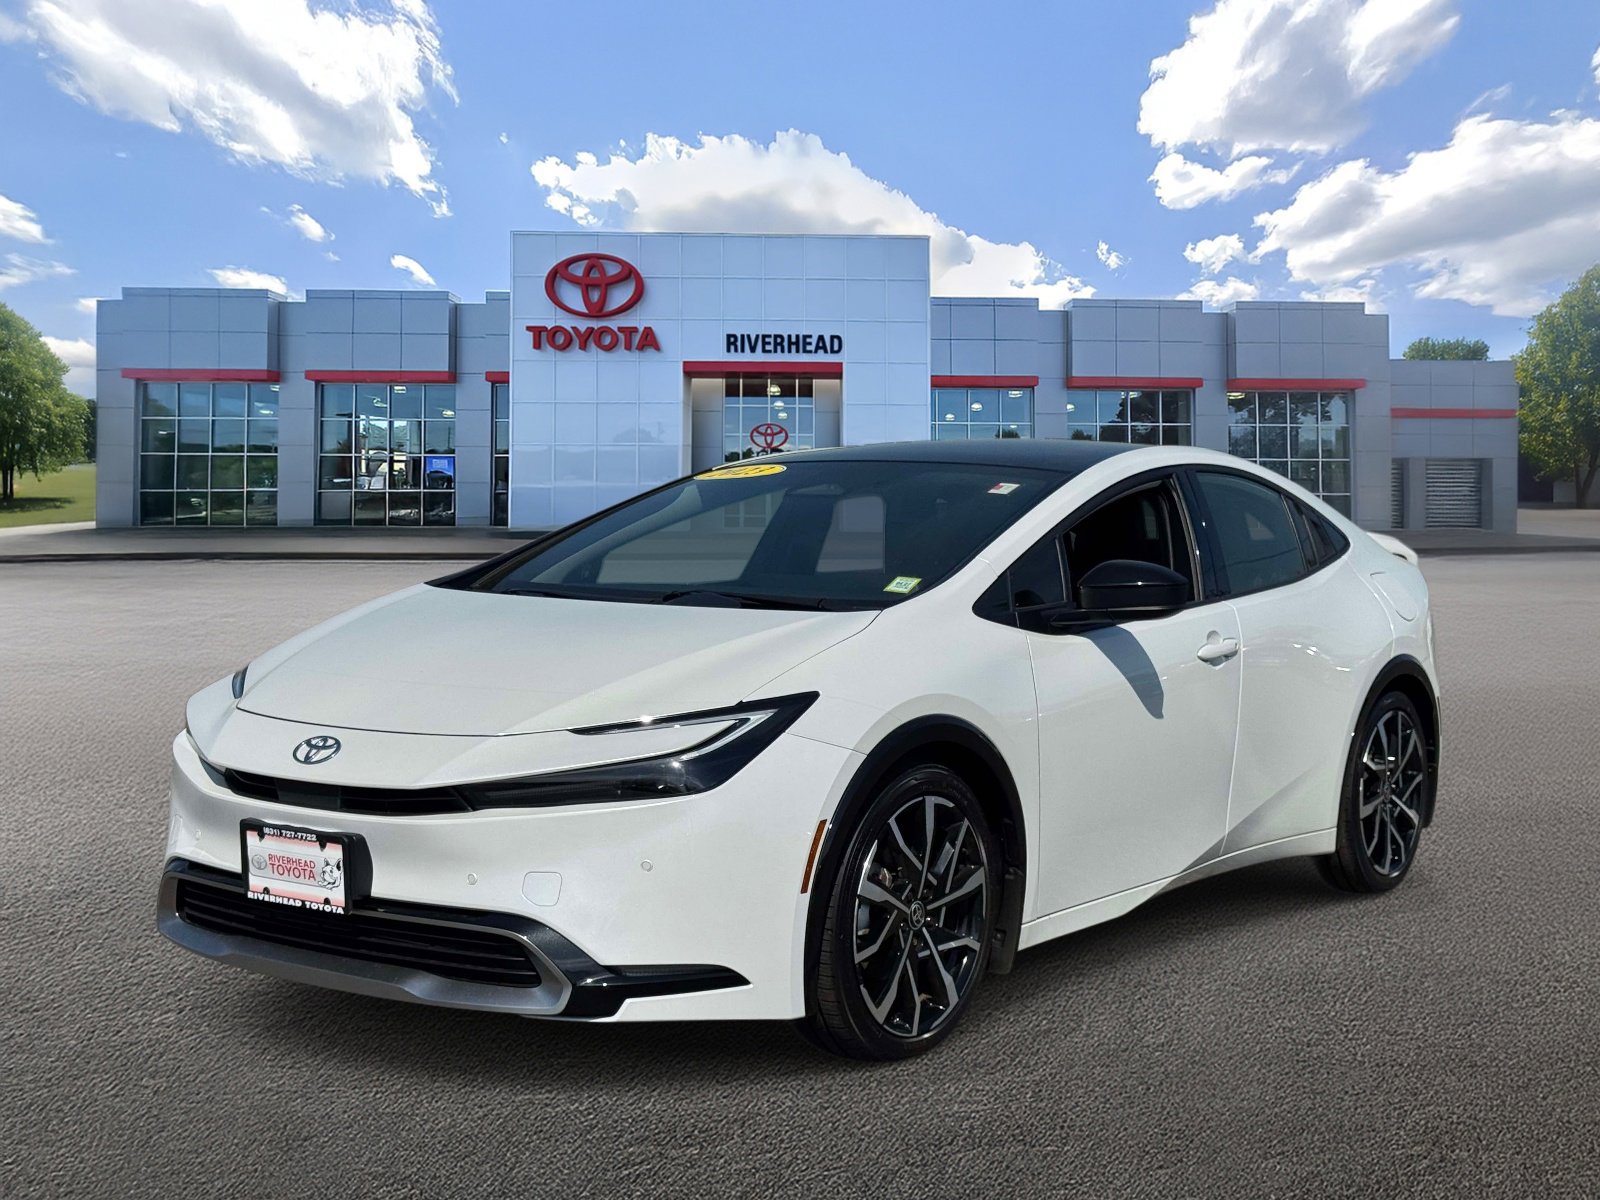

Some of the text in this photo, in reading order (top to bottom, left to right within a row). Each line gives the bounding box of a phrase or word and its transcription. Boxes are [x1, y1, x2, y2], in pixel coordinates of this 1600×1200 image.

[525, 325, 661, 351] TOYOTA
[725, 333, 843, 355] RIVERHEAD
[281, 829, 317, 841] 727-7722
[268, 853, 316, 869] RIVERHEAD
[269, 862, 317, 881] TOYOTA
[247, 891, 344, 914] RIVERHEAD TOYOTA
